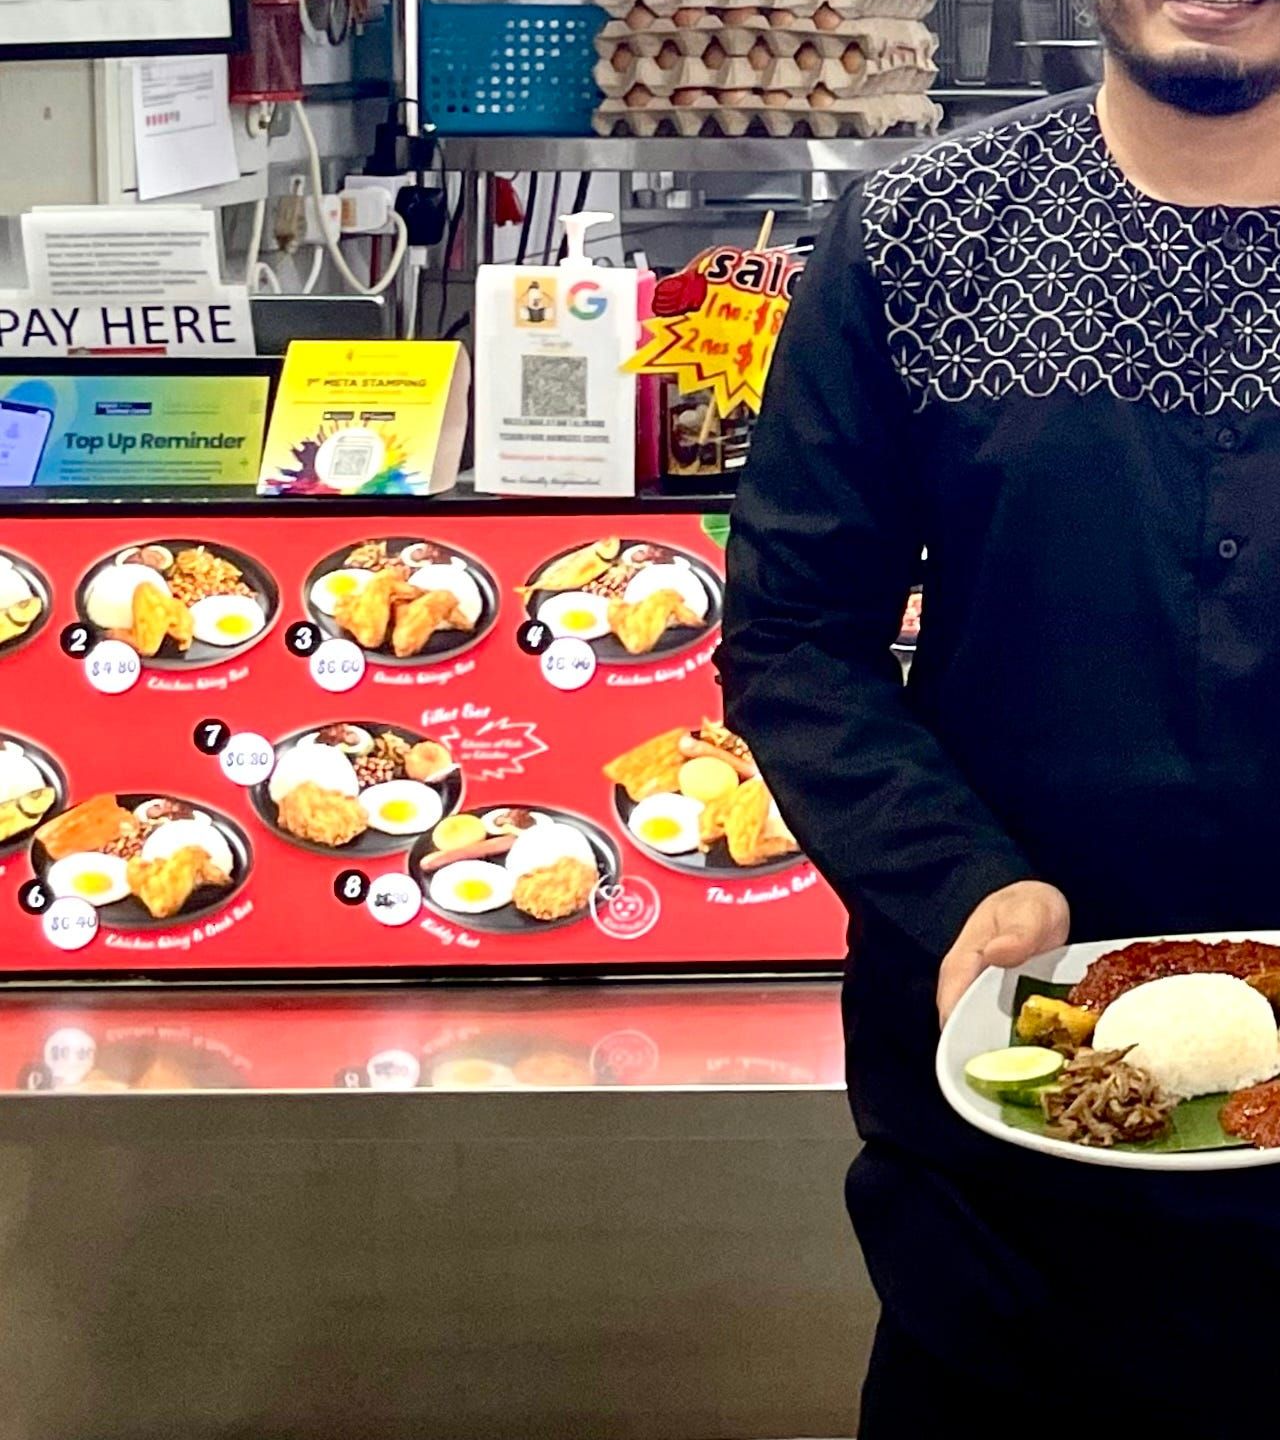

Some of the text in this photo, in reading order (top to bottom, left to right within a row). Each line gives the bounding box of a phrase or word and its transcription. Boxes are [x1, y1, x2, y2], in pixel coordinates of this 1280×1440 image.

[0, 304, 237, 348] PAY HERE
[64, 430, 246, 455] Top Up Reminder
[69, 628, 88, 652] 2
[294, 627, 313, 651] 3
[526, 625, 544, 648] 4
[421, 703, 493, 727] Fillet Set
[204, 724, 222, 748] 7
[27, 884, 46, 908] 6
[343, 874, 362, 899] 8
[705, 871, 819, 906] The Jumbo Set
[105, 933, 158, 950] Chicken
